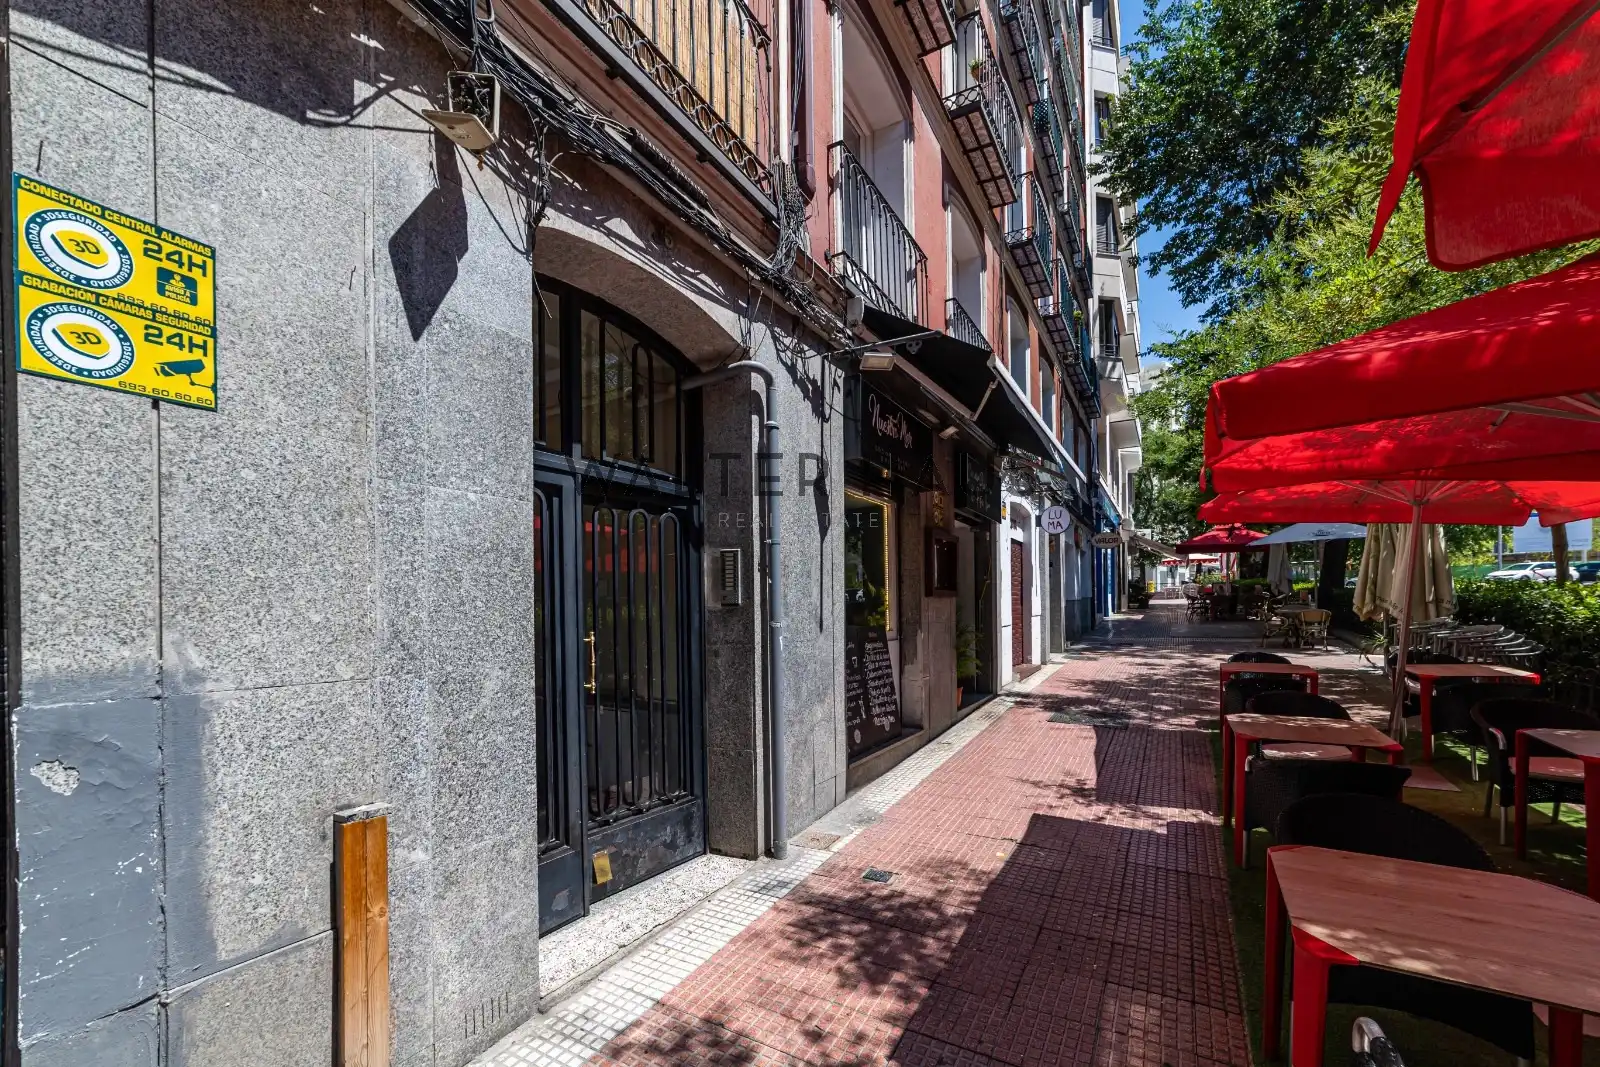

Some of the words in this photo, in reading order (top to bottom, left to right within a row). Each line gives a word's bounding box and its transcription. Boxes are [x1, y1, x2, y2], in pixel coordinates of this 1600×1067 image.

[20, 178, 101, 216] CONECTADO
[104, 210, 158, 236] CENTRAL
[161, 231, 212, 256] ALARMAS
[41, 211, 117, 242] 3DSEGURIDAD
[28, 223, 77, 281] 3DSEGURIDAD
[68, 239, 101, 255] 3D
[143, 238, 207, 277] 24H
[90, 253, 131, 288] 3DSEGURIDAD
[23, 275, 96, 303] GRABACIÓN
[156, 313, 211, 334] SEGURIDAD
[42, 304, 118, 331] 3DSEGURIDAD
[30, 319, 78, 373] 3DSEGURIDAD
[69, 331, 102, 345] 3D
[144, 324, 208, 357] 24H
[92, 341, 132, 377] 3DSEGURIDAD
[118, 380, 213, 406] 693.60.60.60
[1047, 521, 1064, 531] MA
[1048, 509, 1062, 520] LU
